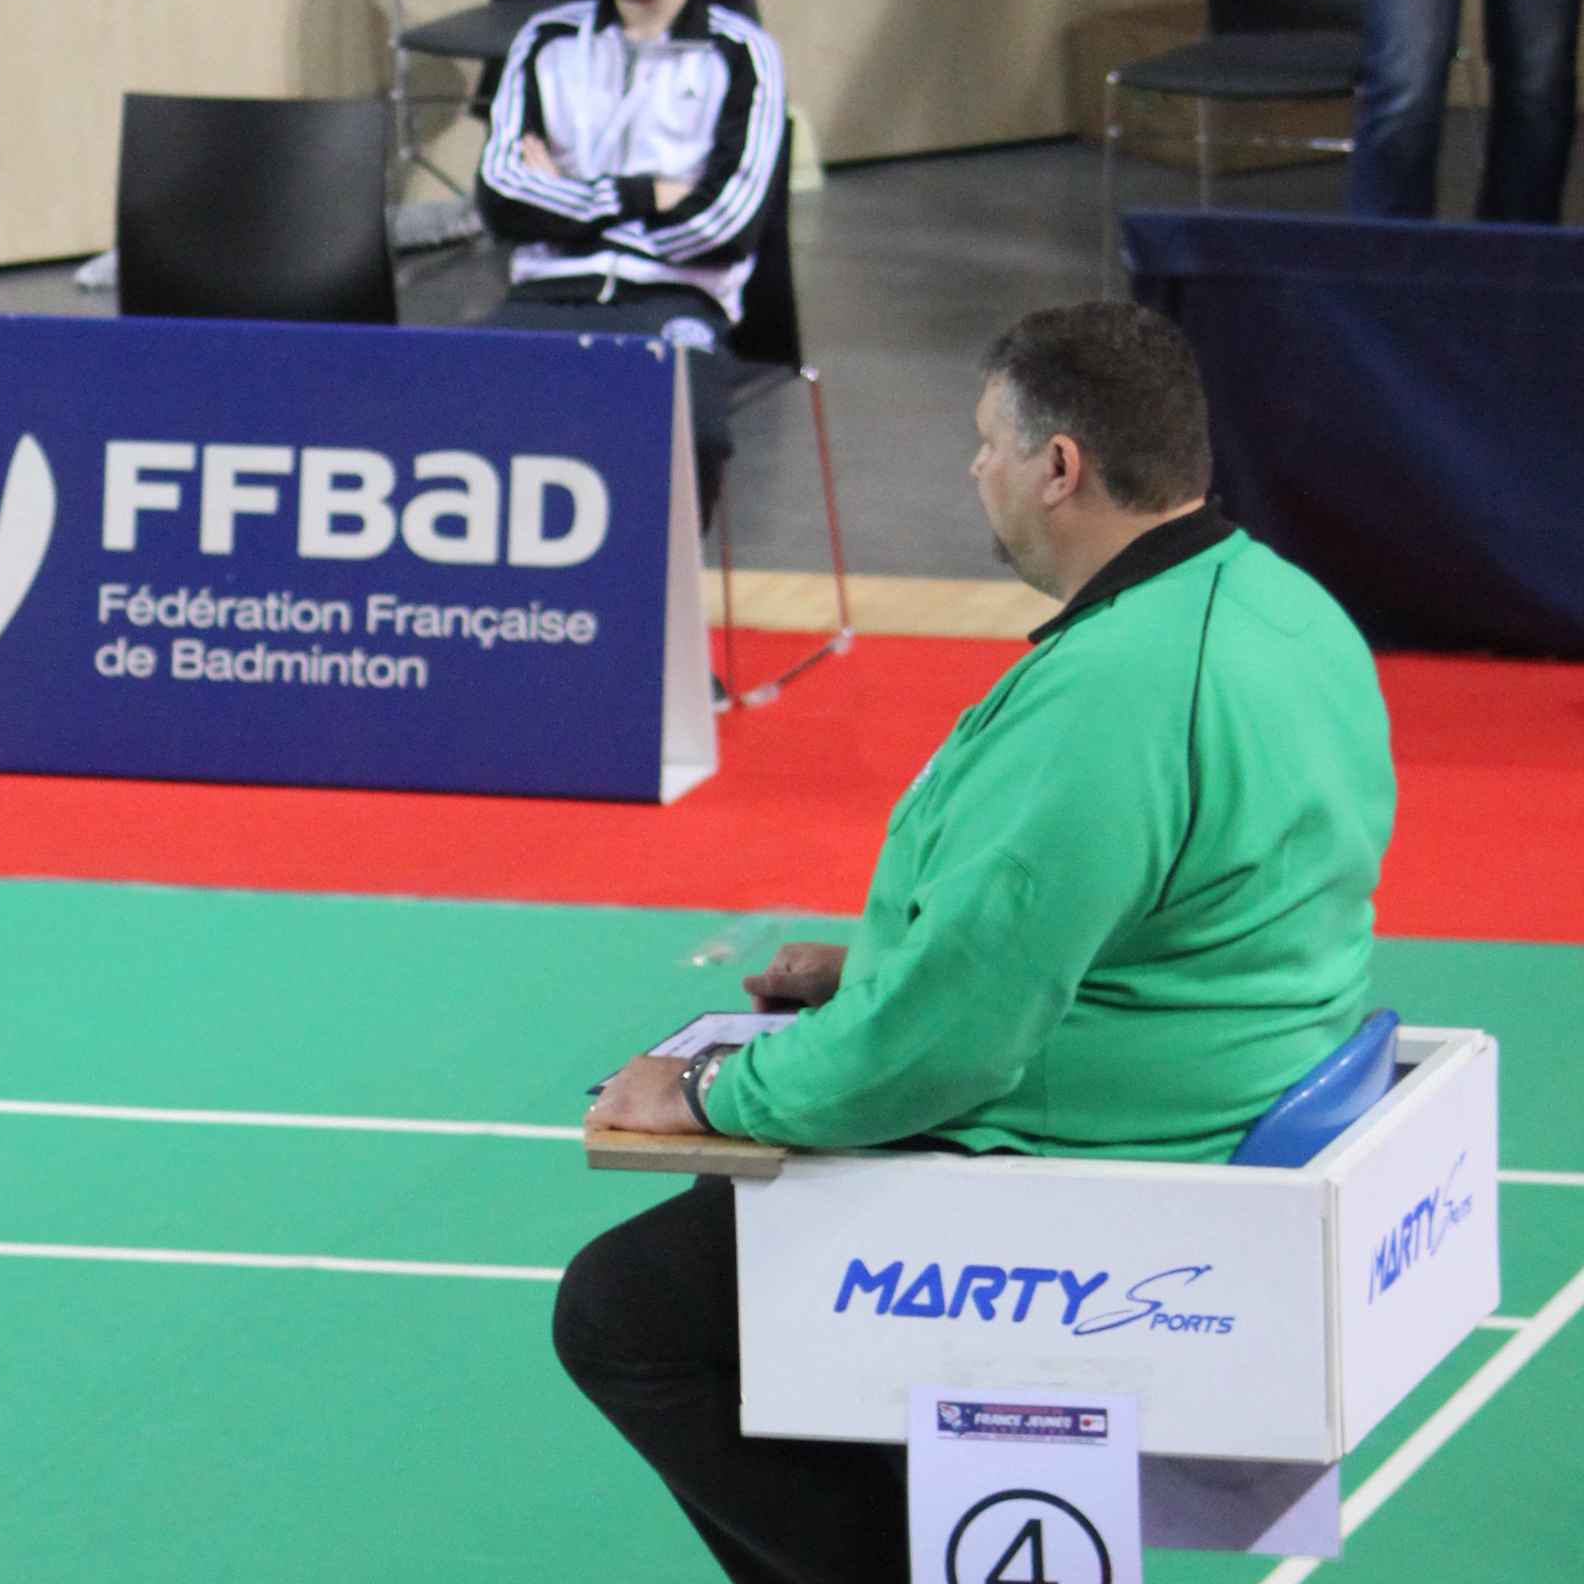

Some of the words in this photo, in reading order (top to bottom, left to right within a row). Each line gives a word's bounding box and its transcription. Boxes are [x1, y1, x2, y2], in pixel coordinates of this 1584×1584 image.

[97, 583, 351, 634] Fédération
[366, 594, 597, 649] Française
[95, 637, 156, 678] de
[171, 638, 427, 688] Badminton
[1368, 1186, 1439, 1304] MARTY
[834, 1258, 1109, 1325] MARTY
